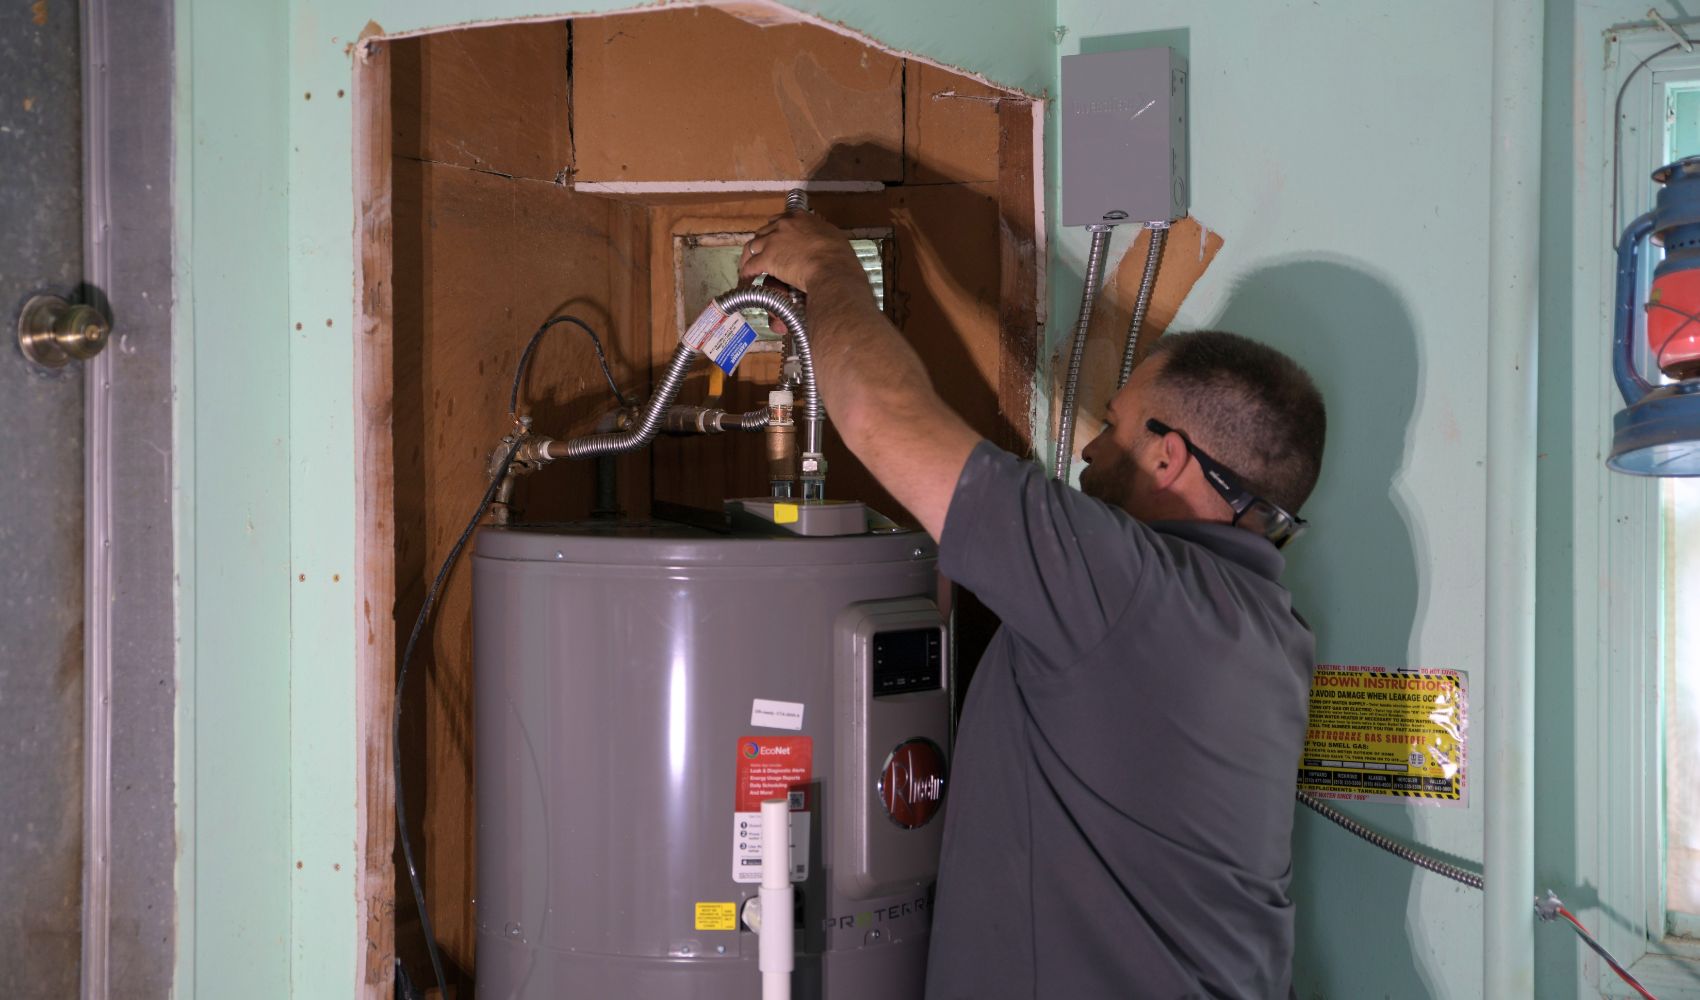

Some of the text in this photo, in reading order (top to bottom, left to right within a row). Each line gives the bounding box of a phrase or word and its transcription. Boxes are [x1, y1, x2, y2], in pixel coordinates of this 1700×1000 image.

[1314, 676, 1360, 687] TDOWN
[1338, 691, 1365, 699] DAMAGE
[1389, 694, 1421, 702] LEAKAGE
[1306, 730, 1426, 745] EARTHQUAKE GAS SHUTOFF
[760, 746, 790, 755] EcoNet
[890, 750, 940, 813] Rheem
